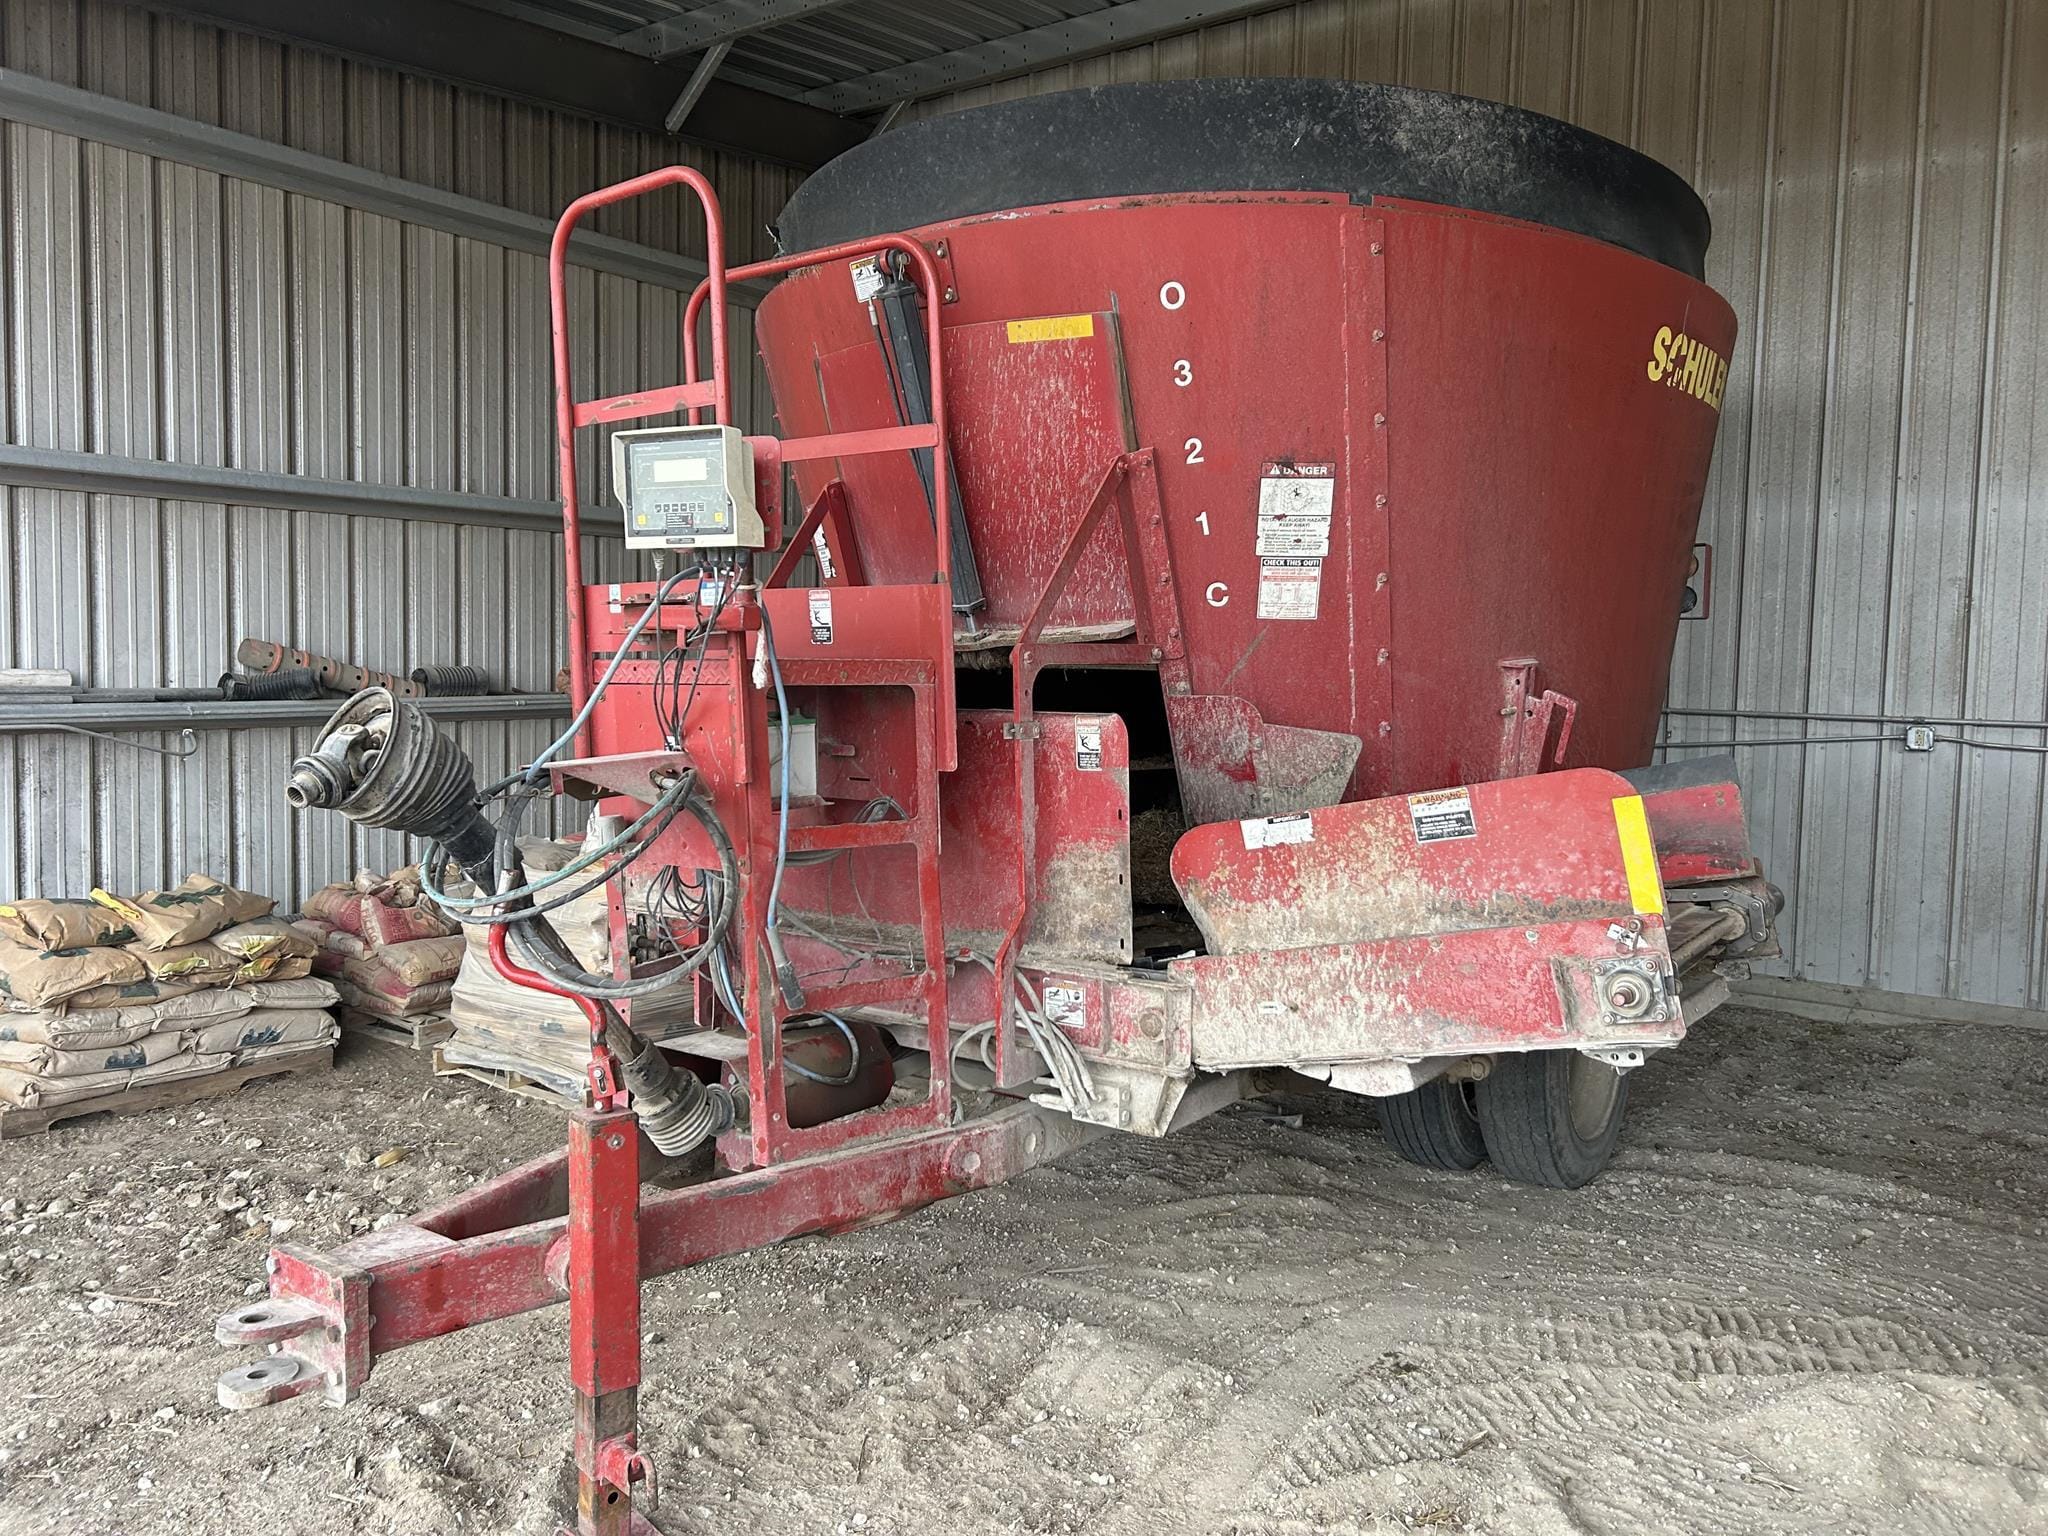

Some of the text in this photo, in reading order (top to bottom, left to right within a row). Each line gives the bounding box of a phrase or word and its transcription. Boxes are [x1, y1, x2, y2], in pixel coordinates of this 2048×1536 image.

[1173, 359, 1193, 387] 3
[1647, 325, 1728, 413] SCHULE
[1184, 437, 1205, 465] 2
[1194, 511, 1210, 536] 1
[1205, 581, 1230, 608] C
[1423, 790, 1462, 803] WARNING
